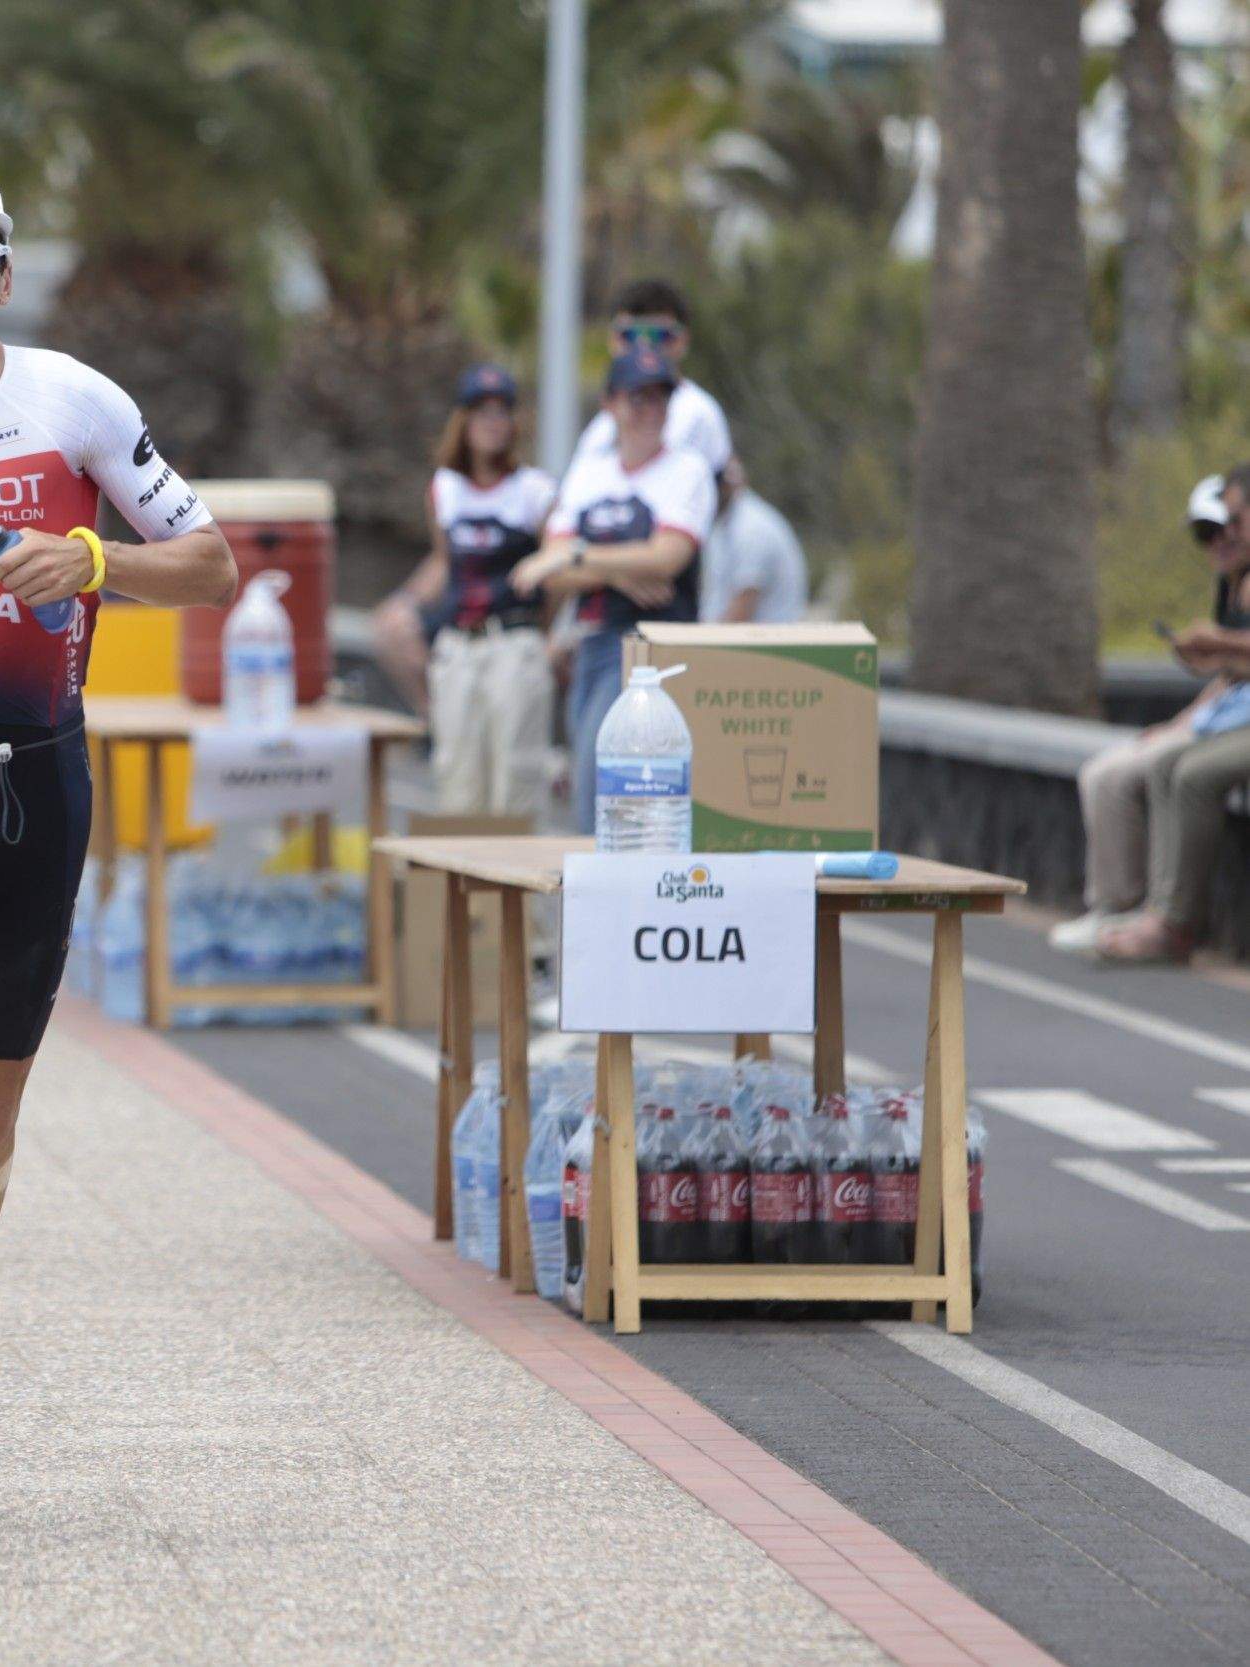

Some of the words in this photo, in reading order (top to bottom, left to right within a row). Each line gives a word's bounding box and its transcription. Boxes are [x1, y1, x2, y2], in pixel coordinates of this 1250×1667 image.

[137, 467, 173, 509] SRA
[694, 688, 824, 709] PAPERCUP
[721, 716, 793, 736] WHITE
[662, 870, 689, 884] Club
[634, 926, 746, 962] COLA
